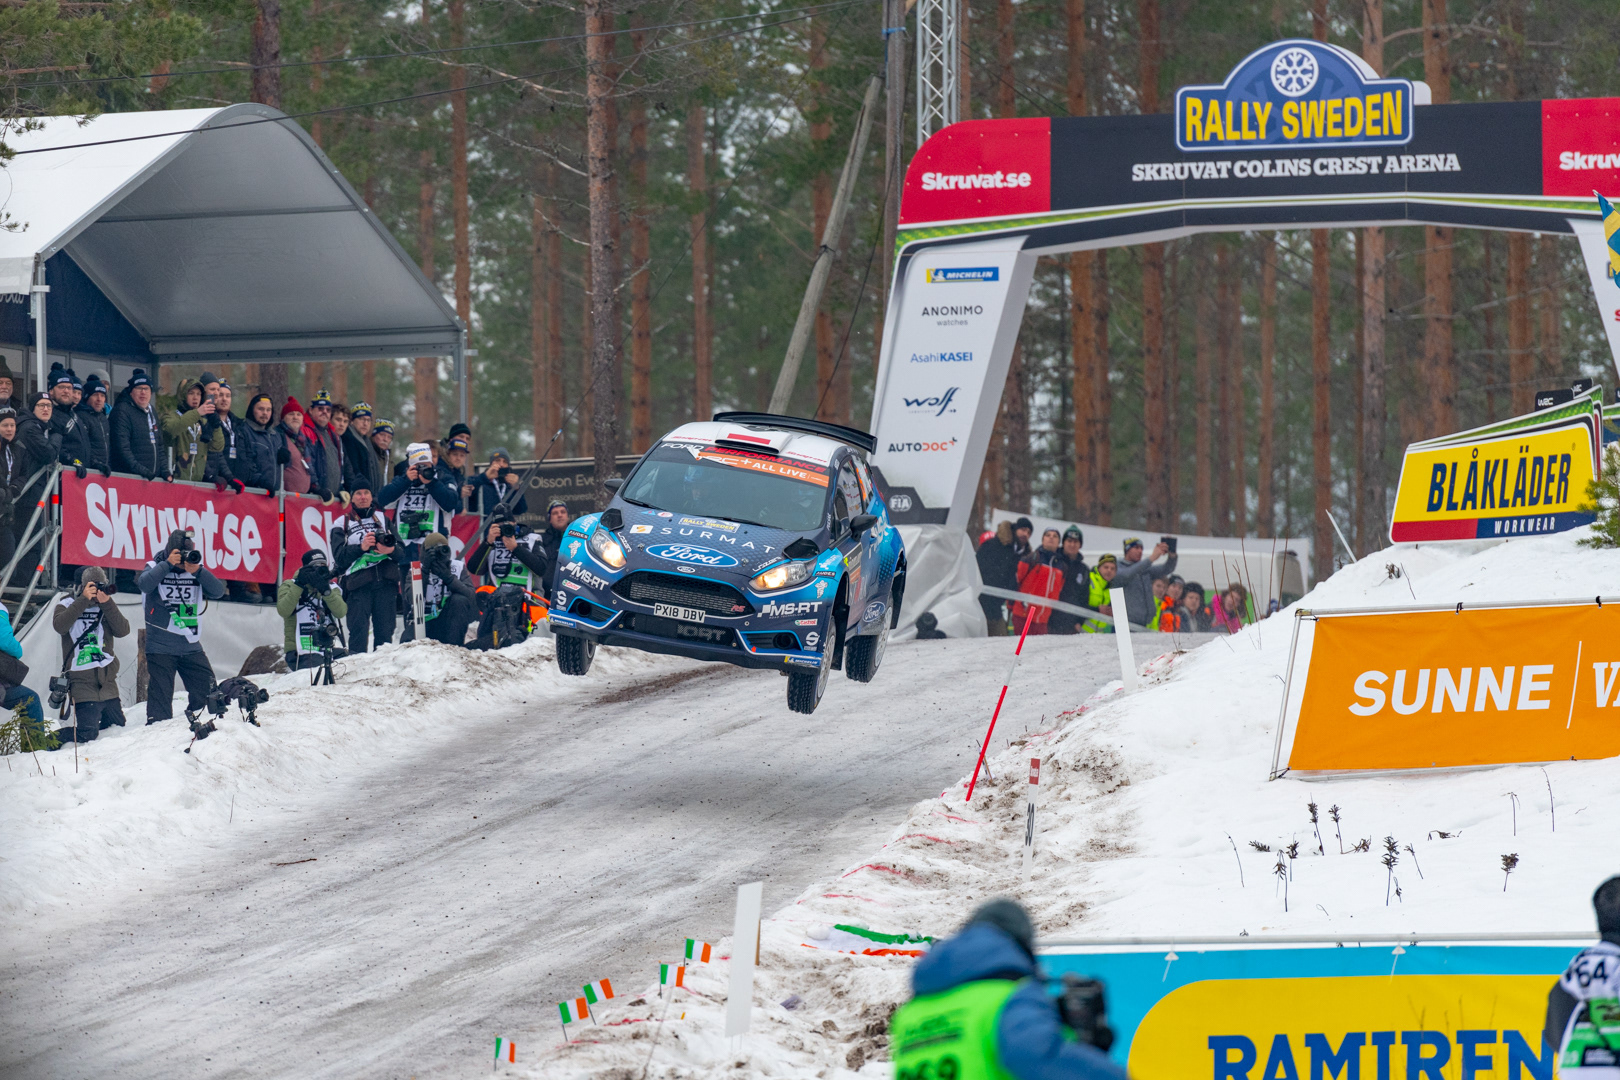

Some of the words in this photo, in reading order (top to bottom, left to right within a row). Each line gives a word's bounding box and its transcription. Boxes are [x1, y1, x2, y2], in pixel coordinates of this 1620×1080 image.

[1185, 96, 1273, 141] RALLY
[1282, 90, 1403, 139] SWEDEN
[1132, 161, 1232, 181] SKRUVAT
[1233, 158, 1312, 178] COLINS
[1313, 155, 1383, 176] CREST
[1384, 153, 1461, 174] ARENA
[921, 171, 1032, 191] Skruvat.se
[946, 271, 994, 279] MICHELIN
[921, 305, 983, 317] ANONIMO
[1538, 397, 1554, 406] WRC
[660, 442, 705, 451] FORD
[888, 442, 949, 453] AUTODOC
[704, 446, 828, 473] PERFORMANCE
[751, 462, 776, 472] ALL
[779, 467, 808, 479] LIVE
[1426, 445, 1572, 512] BLÅKLÄDER
[530, 476, 572, 489] Olsson
[891, 499, 911, 508] FIA
[682, 518, 704, 526] RALLY
[705, 521, 735, 531] SWEDEN
[1495, 516, 1556, 534] WORKWEAR
[660, 527, 775, 554] SURMAT
[660, 544, 721, 565] Ford
[165, 586, 192, 600] 235
[655, 604, 680, 618] PX18
[683, 609, 705, 622] DBV
[769, 602, 823, 616] MS-RT
[1348, 664, 1554, 717] SUNNE
